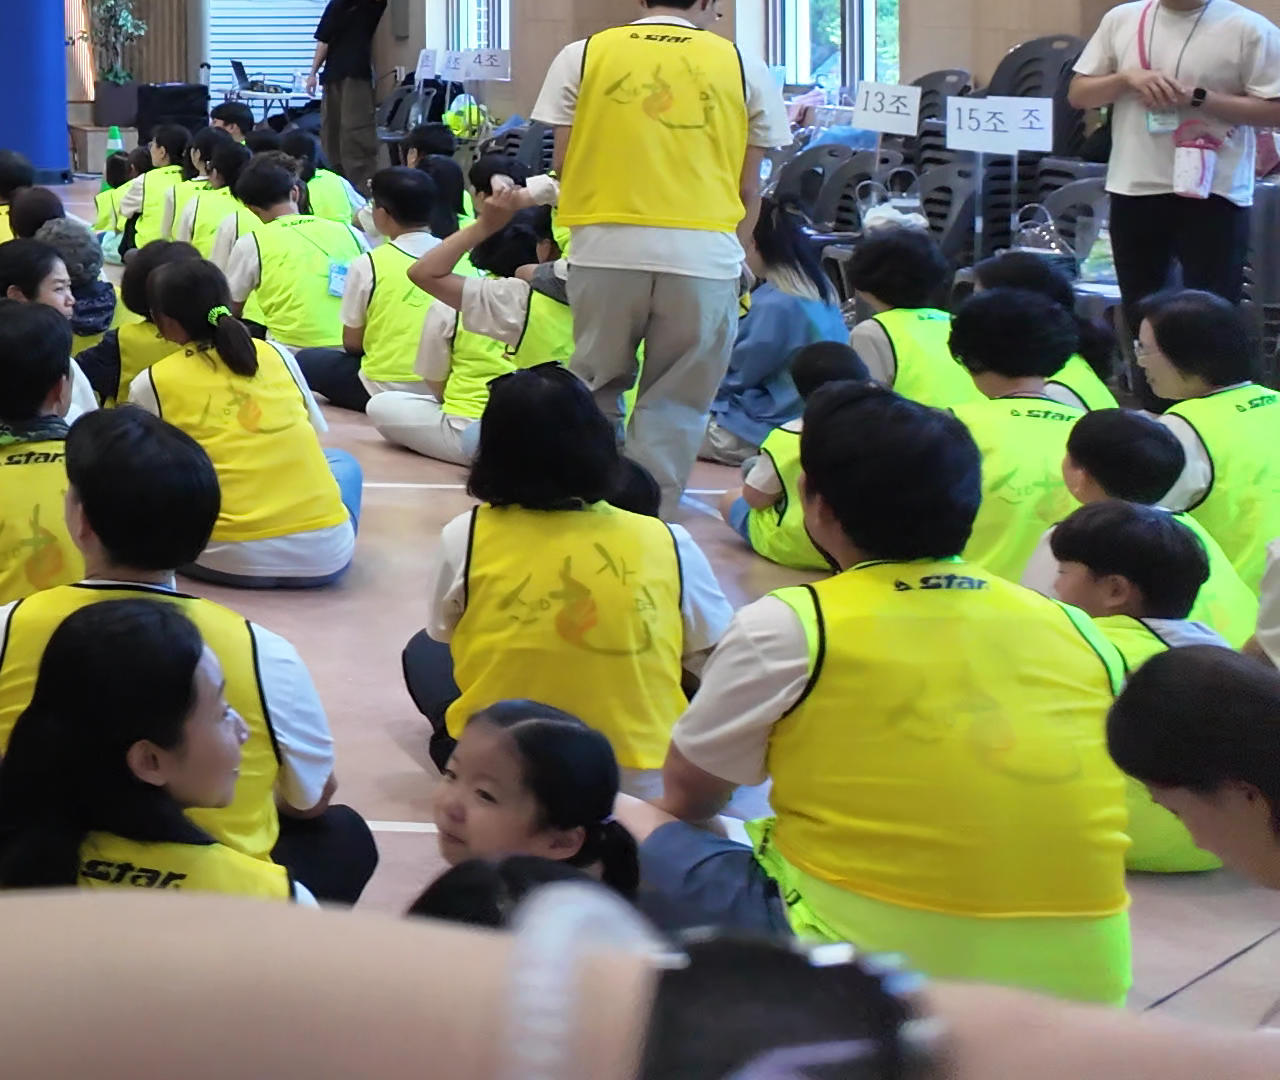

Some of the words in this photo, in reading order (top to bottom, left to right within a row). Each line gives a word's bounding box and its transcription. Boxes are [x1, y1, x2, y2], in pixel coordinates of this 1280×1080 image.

[473, 53, 500, 67] 4조
[862, 90, 911, 116] 13조
[956, 107, 1009, 133] 15조
[1019, 108, 1045, 130] 조
